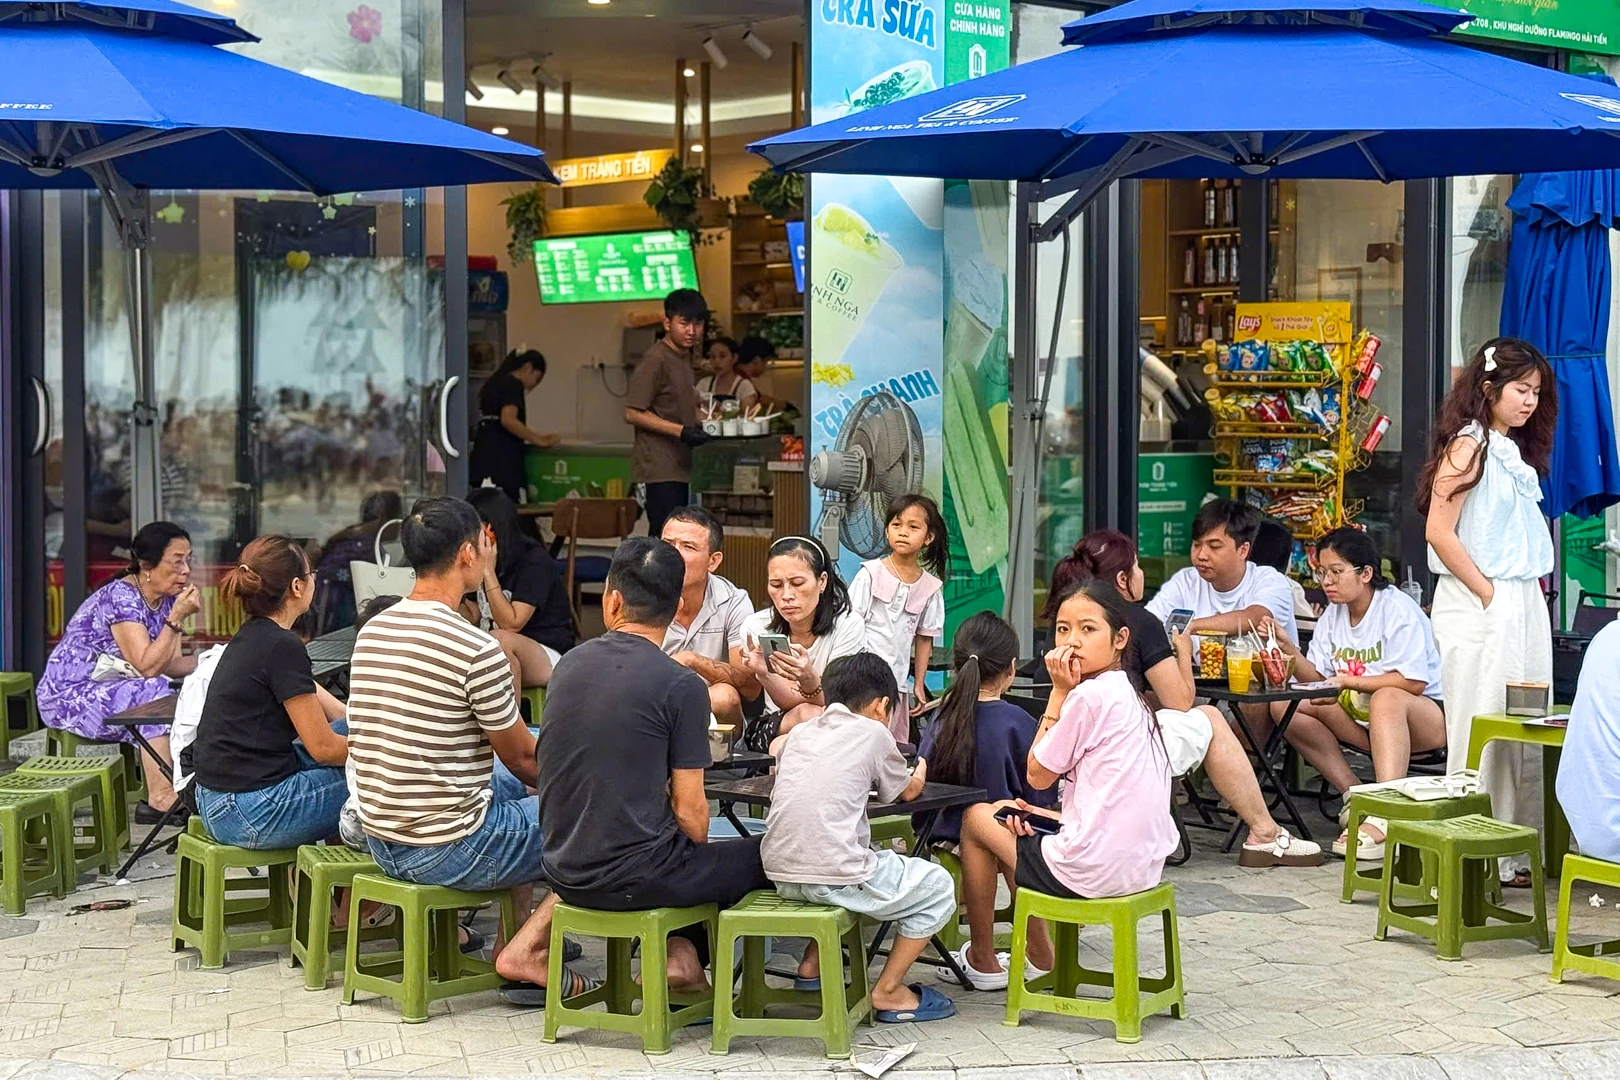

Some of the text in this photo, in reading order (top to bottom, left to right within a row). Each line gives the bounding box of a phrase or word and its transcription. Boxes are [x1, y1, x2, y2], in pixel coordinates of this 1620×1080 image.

[975, 2, 1001, 20] HÀNG
[979, 21, 1005, 37] HÀNG
[1493, 20, 1508, 30] KHU
[1548, 28, 1581, 42] FLAMINGO
[552, 164, 578, 181] KEM
[834, 296, 858, 315] NGA
